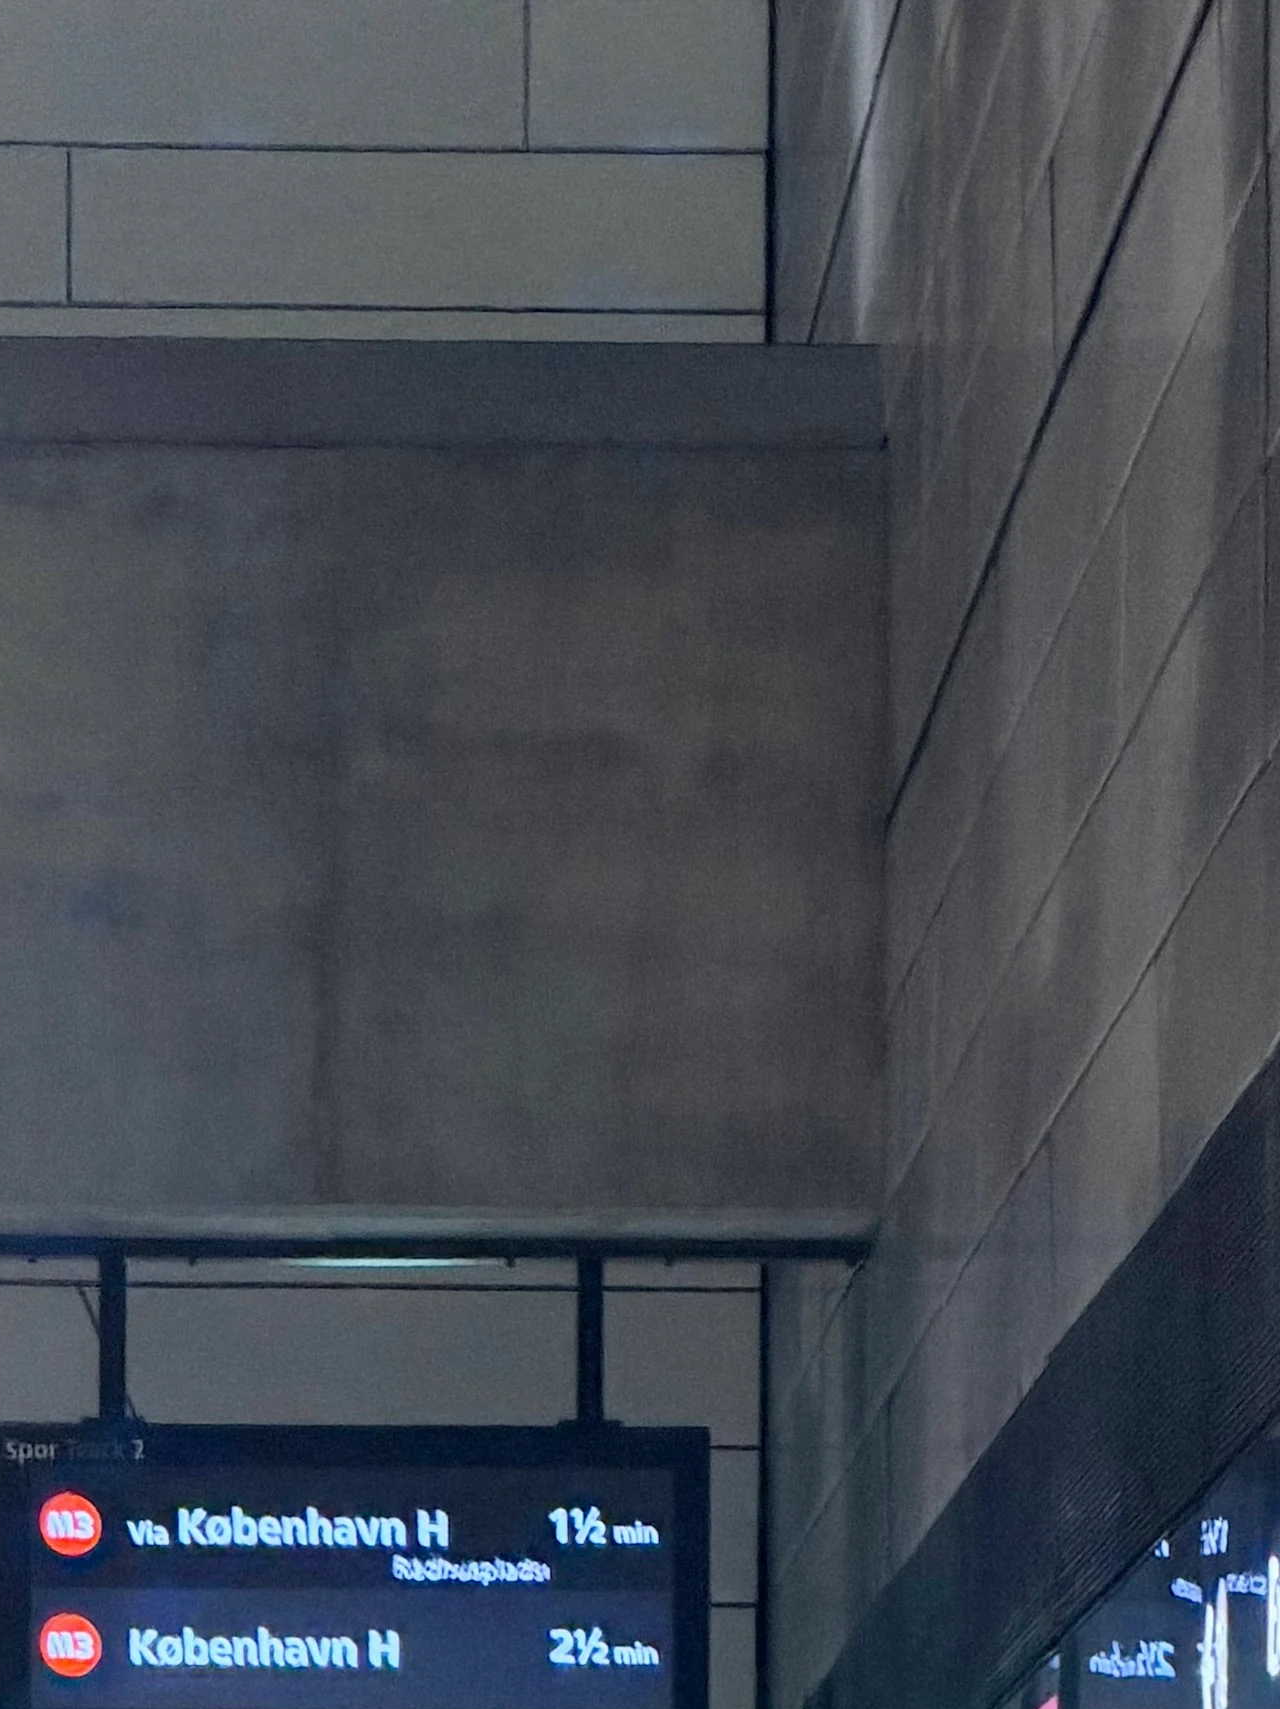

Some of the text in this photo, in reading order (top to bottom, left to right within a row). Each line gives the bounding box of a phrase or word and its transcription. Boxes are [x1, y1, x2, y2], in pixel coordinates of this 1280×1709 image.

[6, 1438, 57, 1464] Spor
[47, 1511, 95, 1539] M3
[127, 1505, 449, 1548] Via København H
[612, 1520, 660, 1545] min
[47, 1631, 95, 1660] M3
[128, 1626, 401, 1669] København H
[612, 1640, 660, 1666] min
